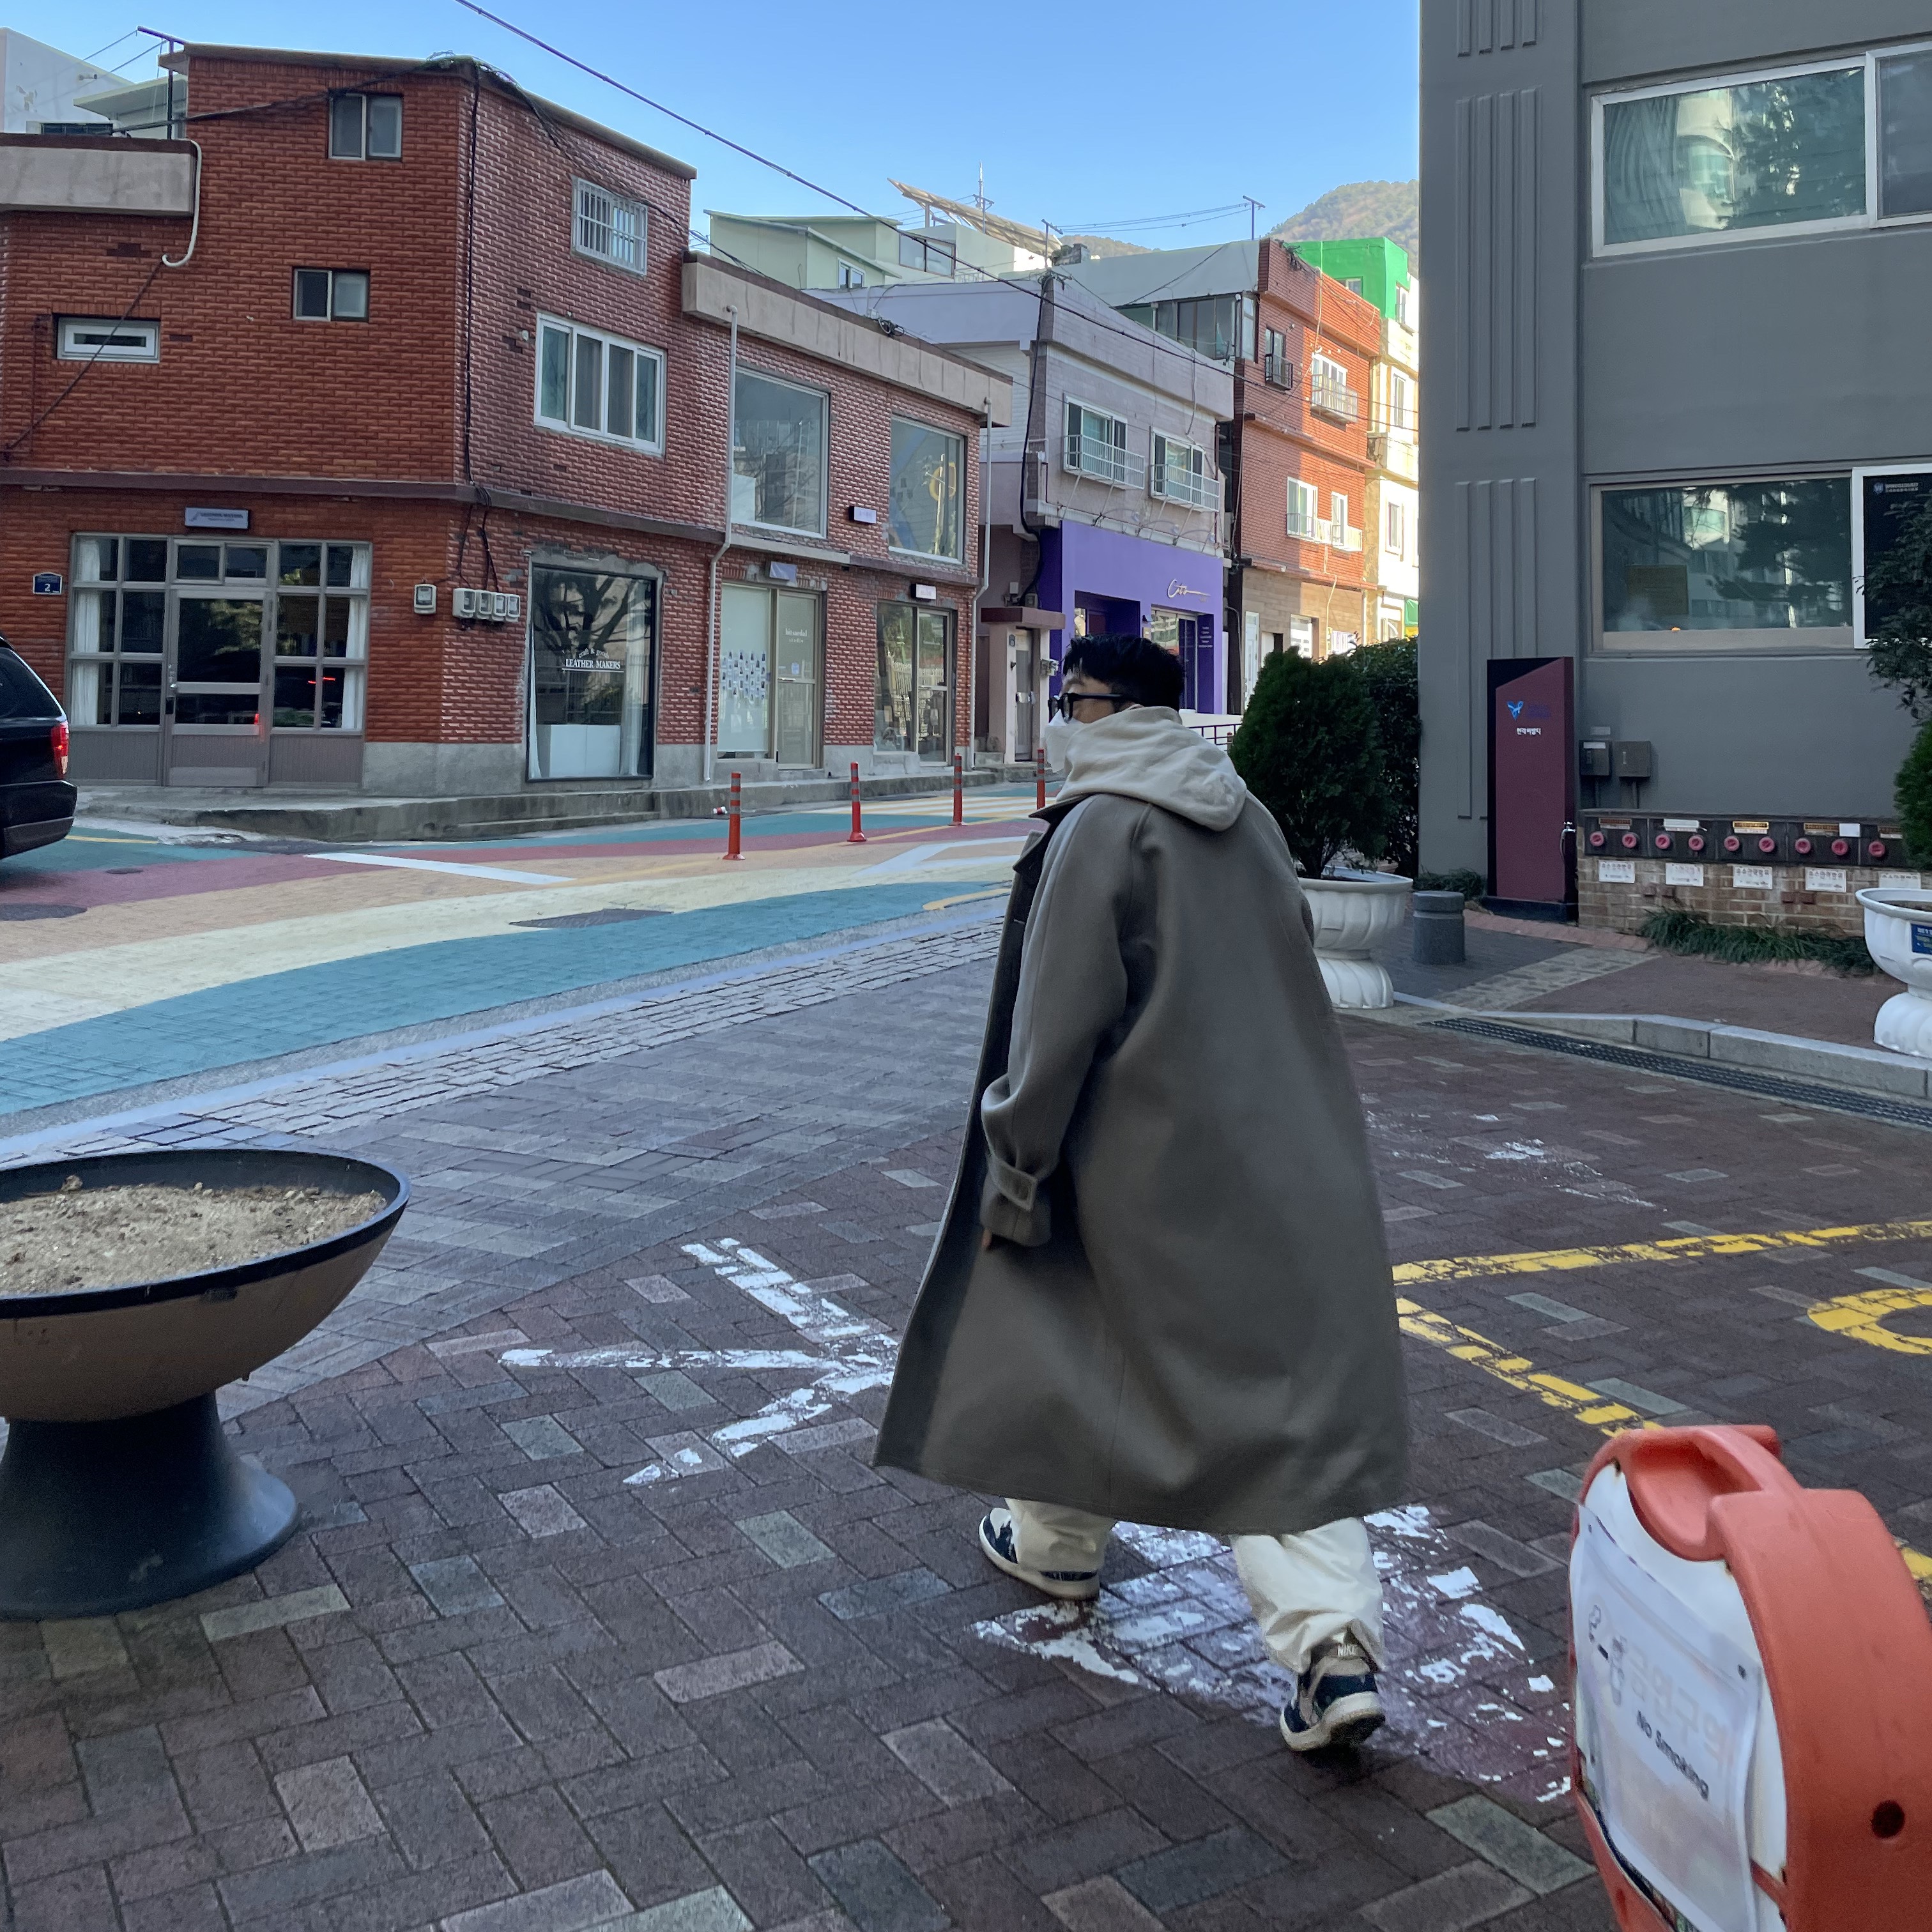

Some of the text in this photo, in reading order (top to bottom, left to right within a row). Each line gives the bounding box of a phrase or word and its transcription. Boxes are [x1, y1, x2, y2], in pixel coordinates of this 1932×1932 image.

[44, 583, 51, 592] 2
[565, 659, 620, 670] LEATHER MAKERS
[1637, 1710, 1710, 1802] No Smoking
